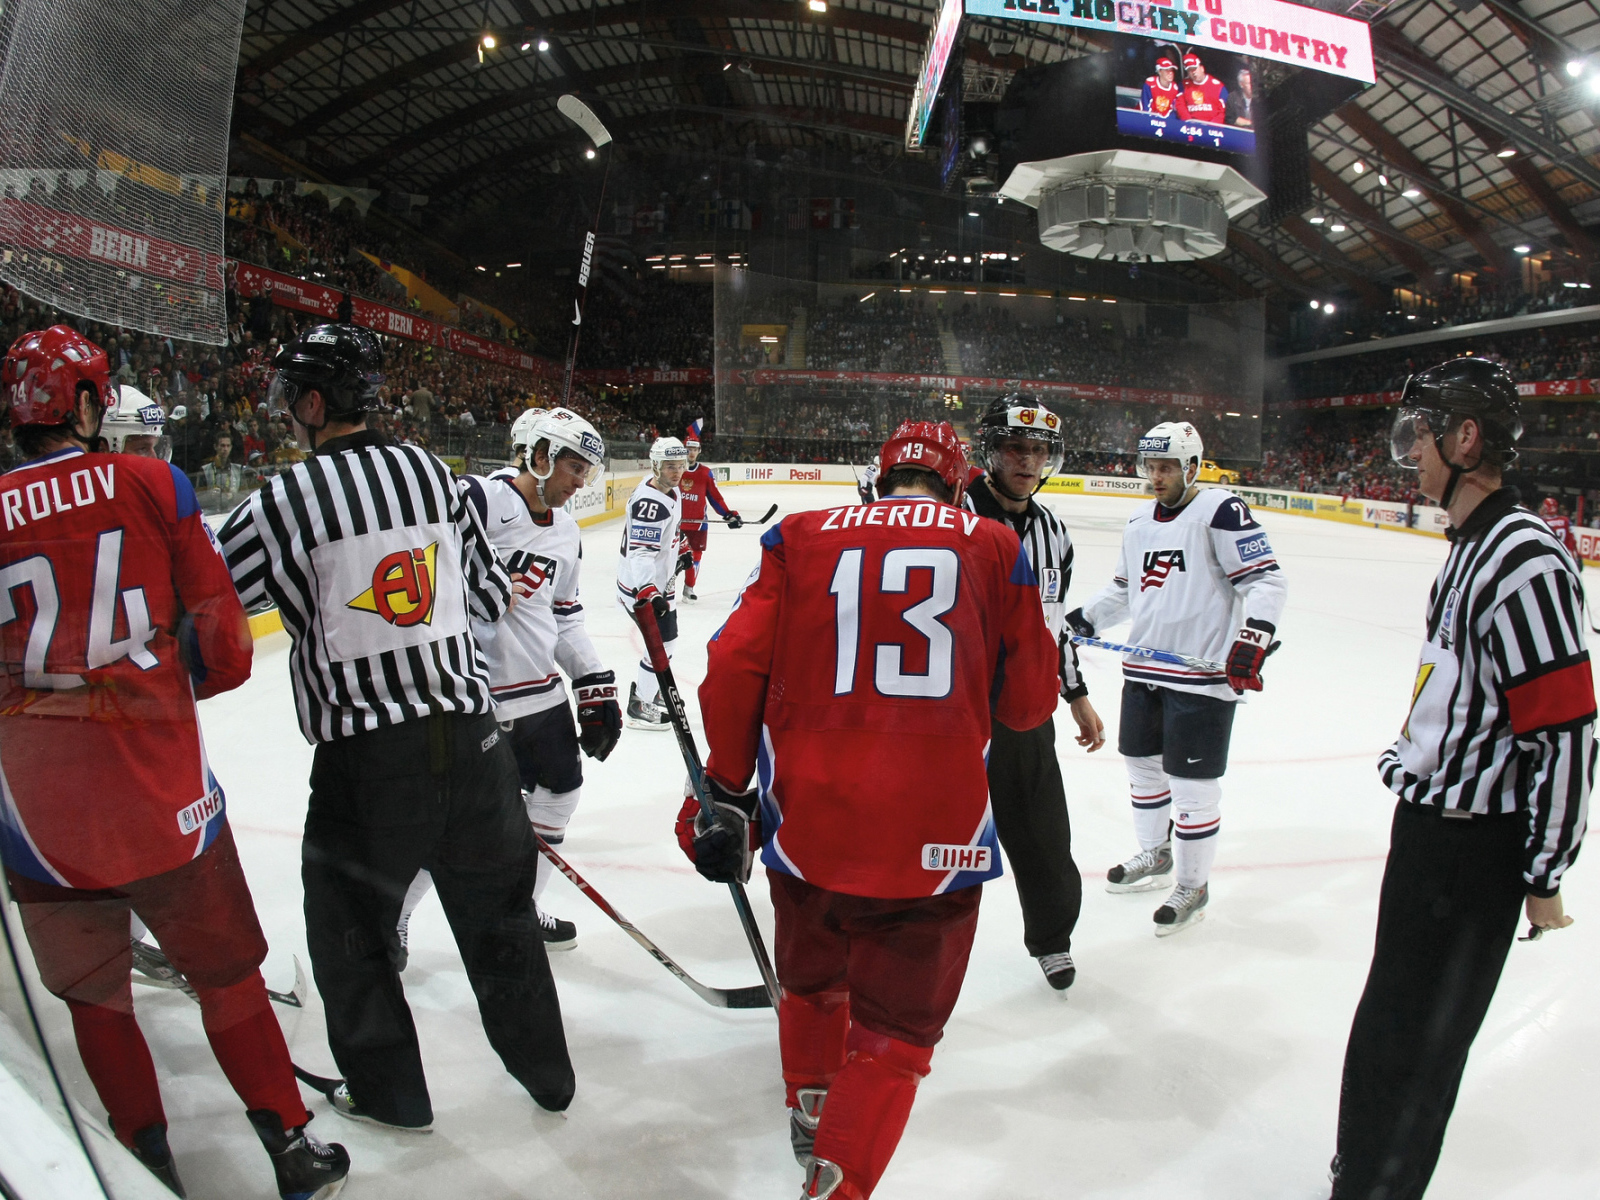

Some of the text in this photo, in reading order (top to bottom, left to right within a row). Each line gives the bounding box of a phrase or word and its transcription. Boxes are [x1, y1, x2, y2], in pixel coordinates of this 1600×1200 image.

[1067, 0, 1199, 36] HOCKEY
[1210, 17, 1348, 69] COUNTRY
[1151, 119, 1167, 128] RUS
[1180, 125, 1203, 138] 4:54
[1155, 128, 1163, 138] 4
[1208, 129, 1224, 138] USA
[89, 225, 150, 268] BERN
[578, 231, 596, 288] BAUER
[273, 280, 296, 295] WELCOME
[297, 287, 304, 296] TO
[299, 296, 320, 309] COUNTRY
[388, 312, 413, 336] BERN
[308, 334, 337, 345] CCM
[653, 371, 689, 382] BERN
[920, 376, 956, 390] BERN
[11, 380, 27, 406] 24
[1171, 393, 1204, 408] BERN
[905, 442, 924, 460] 13
[751, 468, 773, 479] IIHF
[790, 469, 821, 480] Persil
[1106, 480, 1142, 489] TISSOT
[1, 463, 115, 532] ROLOV
[637, 501, 659, 520] 26
[820, 503, 980, 537] ZHERDEV
[1140, 549, 1186, 592] USA
[0, 526, 161, 691] 24
[828, 546, 961, 698] 13
[192, 790, 219, 825] IIHF
[942, 848, 987, 868] IIHF
